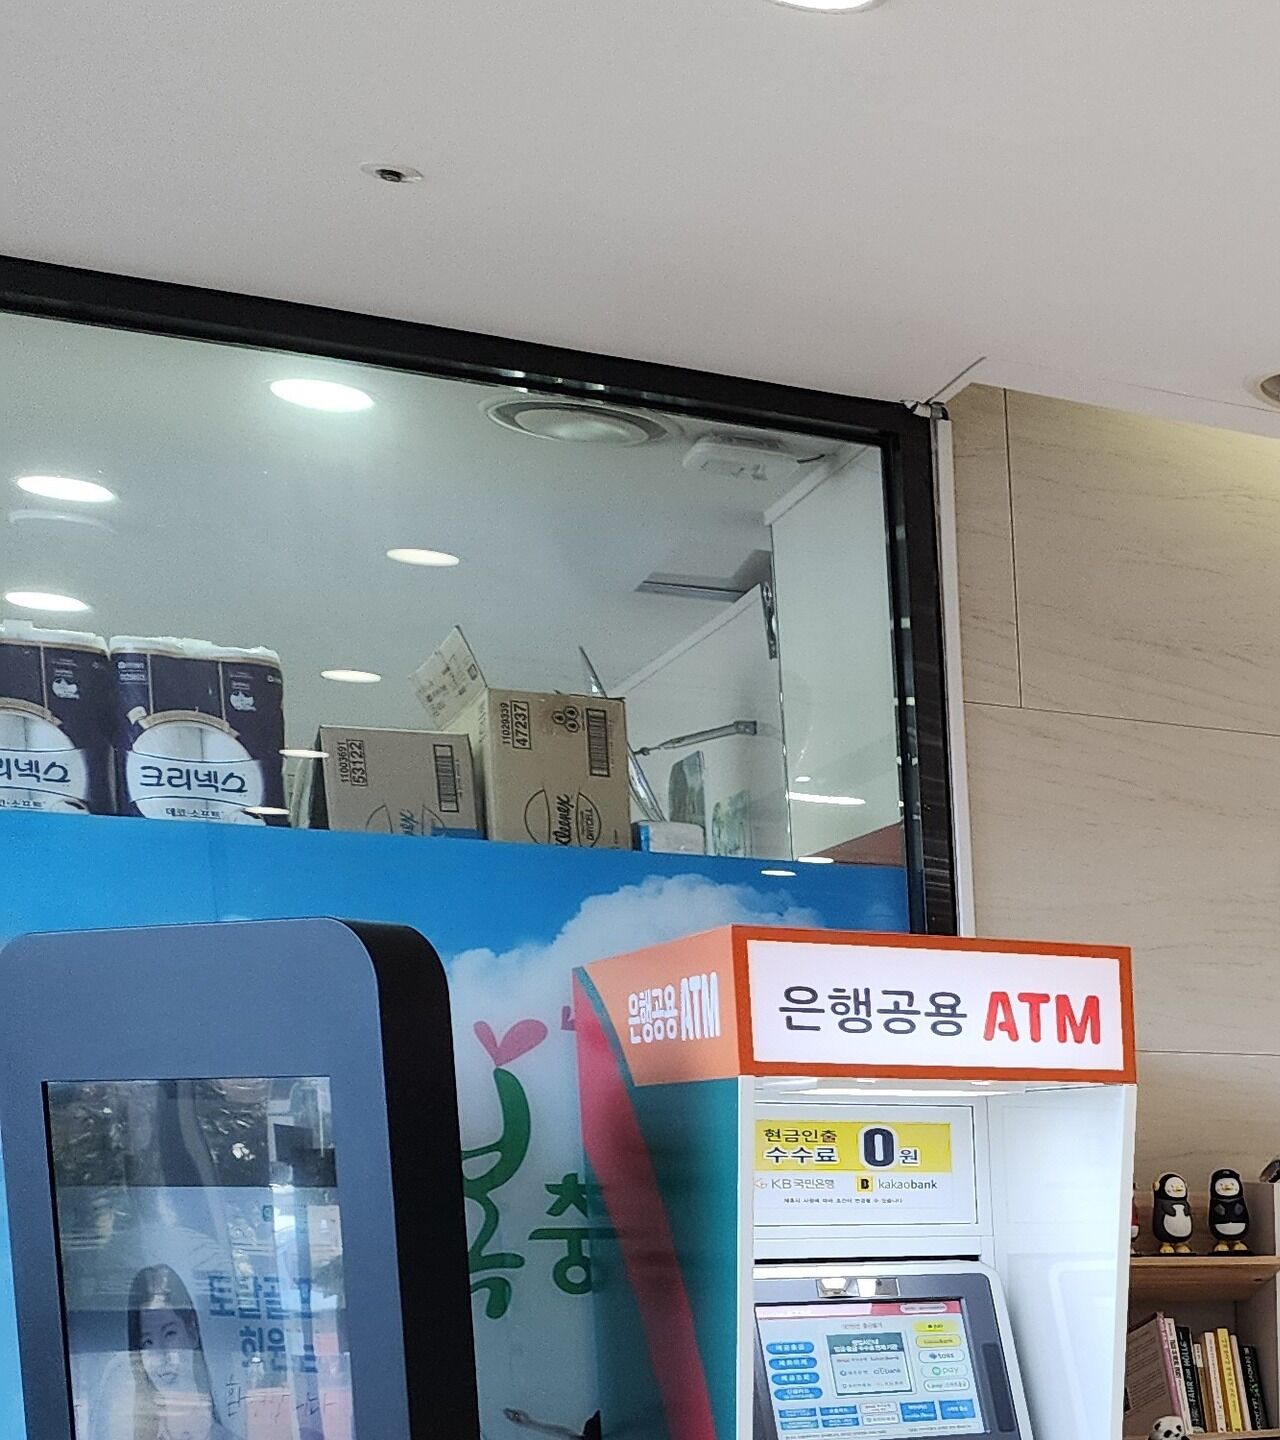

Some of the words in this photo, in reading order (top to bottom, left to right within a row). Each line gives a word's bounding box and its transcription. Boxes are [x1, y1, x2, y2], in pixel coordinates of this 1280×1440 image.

[513, 703, 529, 746] 47237
[140, 765, 248, 793] 크리넥스
[337, 741, 350, 782] 11003691
[349, 740, 366, 785] 53122
[628, 983, 679, 1045] 은행공용
[680, 970, 721, 1041] ATM
[778, 985, 968, 1038] 은행공용
[983, 990, 1101, 1045] ATM
[764, 1128, 838, 1143] 현금인출
[863, 1127, 895, 1167] 0
[900, 1148, 918, 1165] 원
[765, 1147, 838, 1163] 수수료
[878, 1178, 938, 1190] kakaobank
[938, 1351, 955, 1360] toss
[942, 1366, 959, 1375] pay
